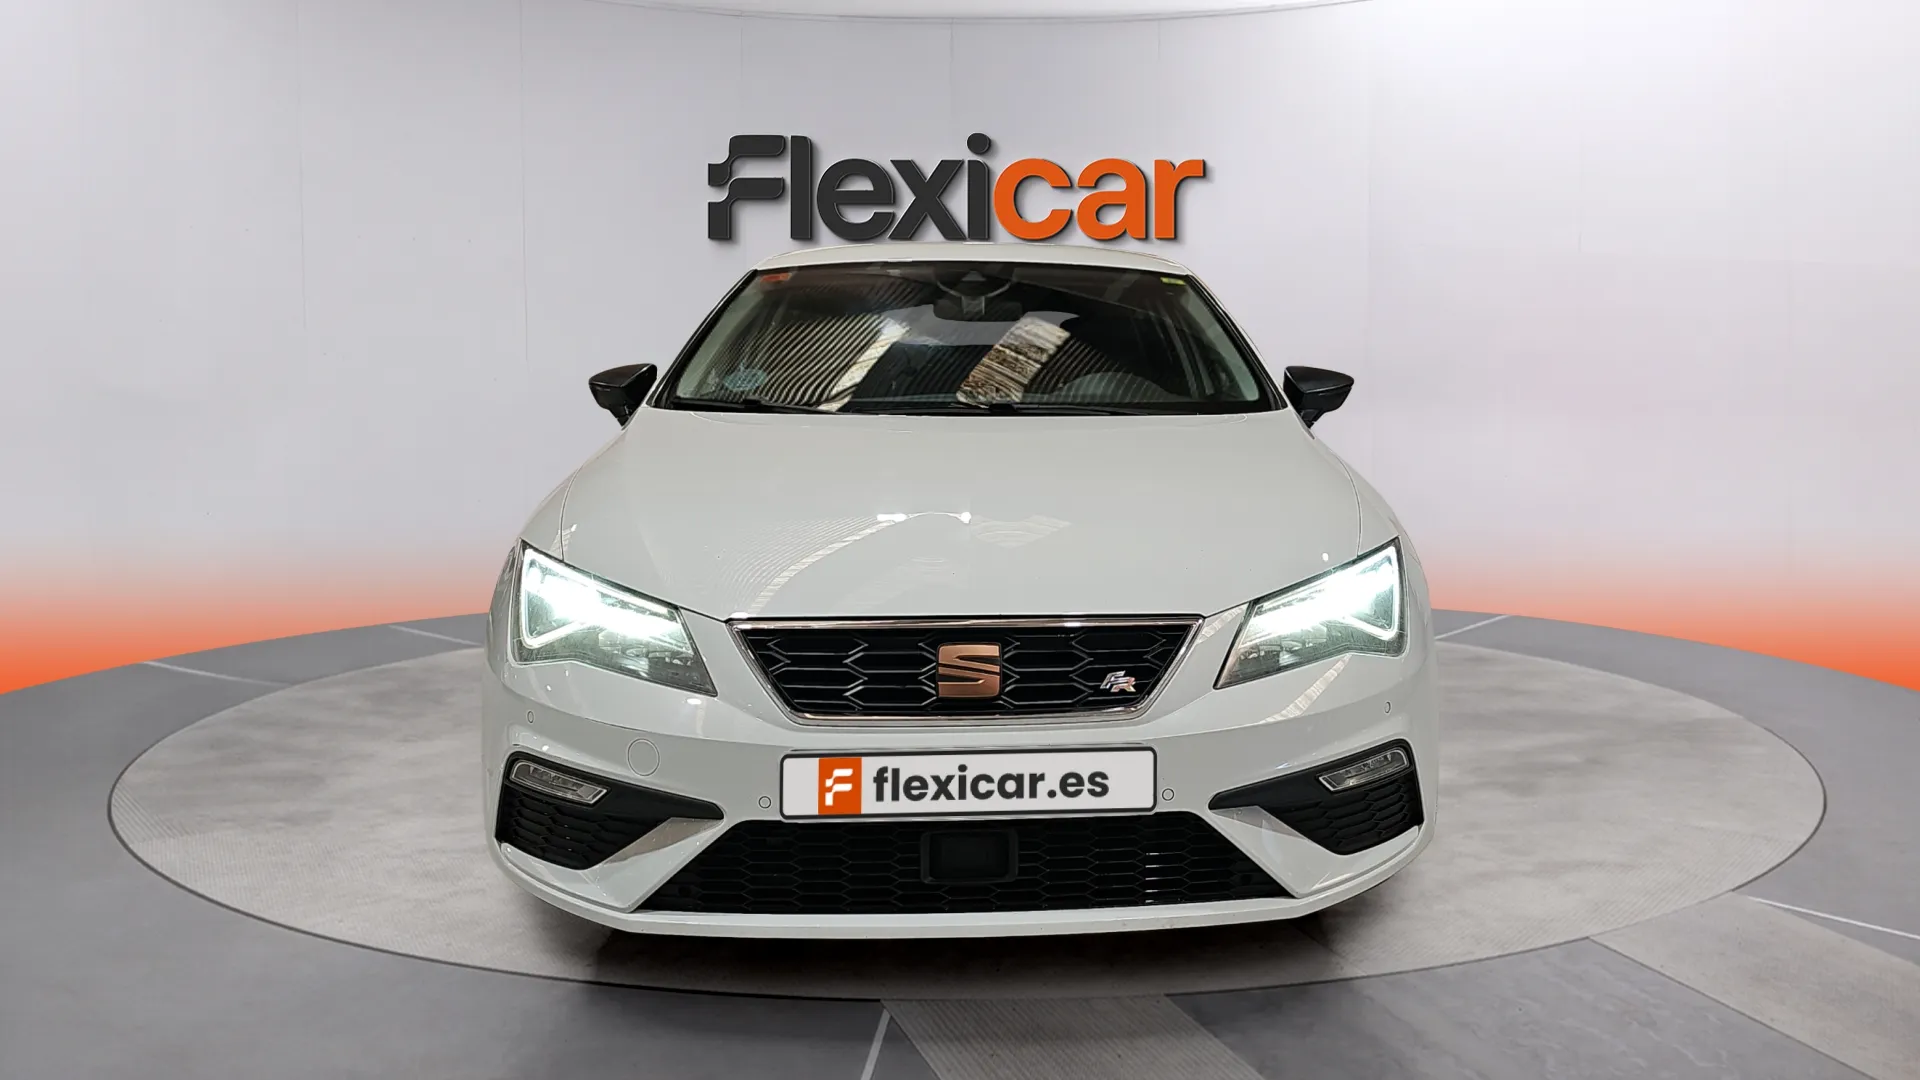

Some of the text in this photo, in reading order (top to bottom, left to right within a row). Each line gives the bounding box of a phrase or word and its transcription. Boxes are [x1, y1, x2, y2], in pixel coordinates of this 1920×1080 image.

[708, 132, 1204, 240] Flexicar
[1100, 670, 1136, 692] FR
[873, 764, 1110, 802] flexicar.es
